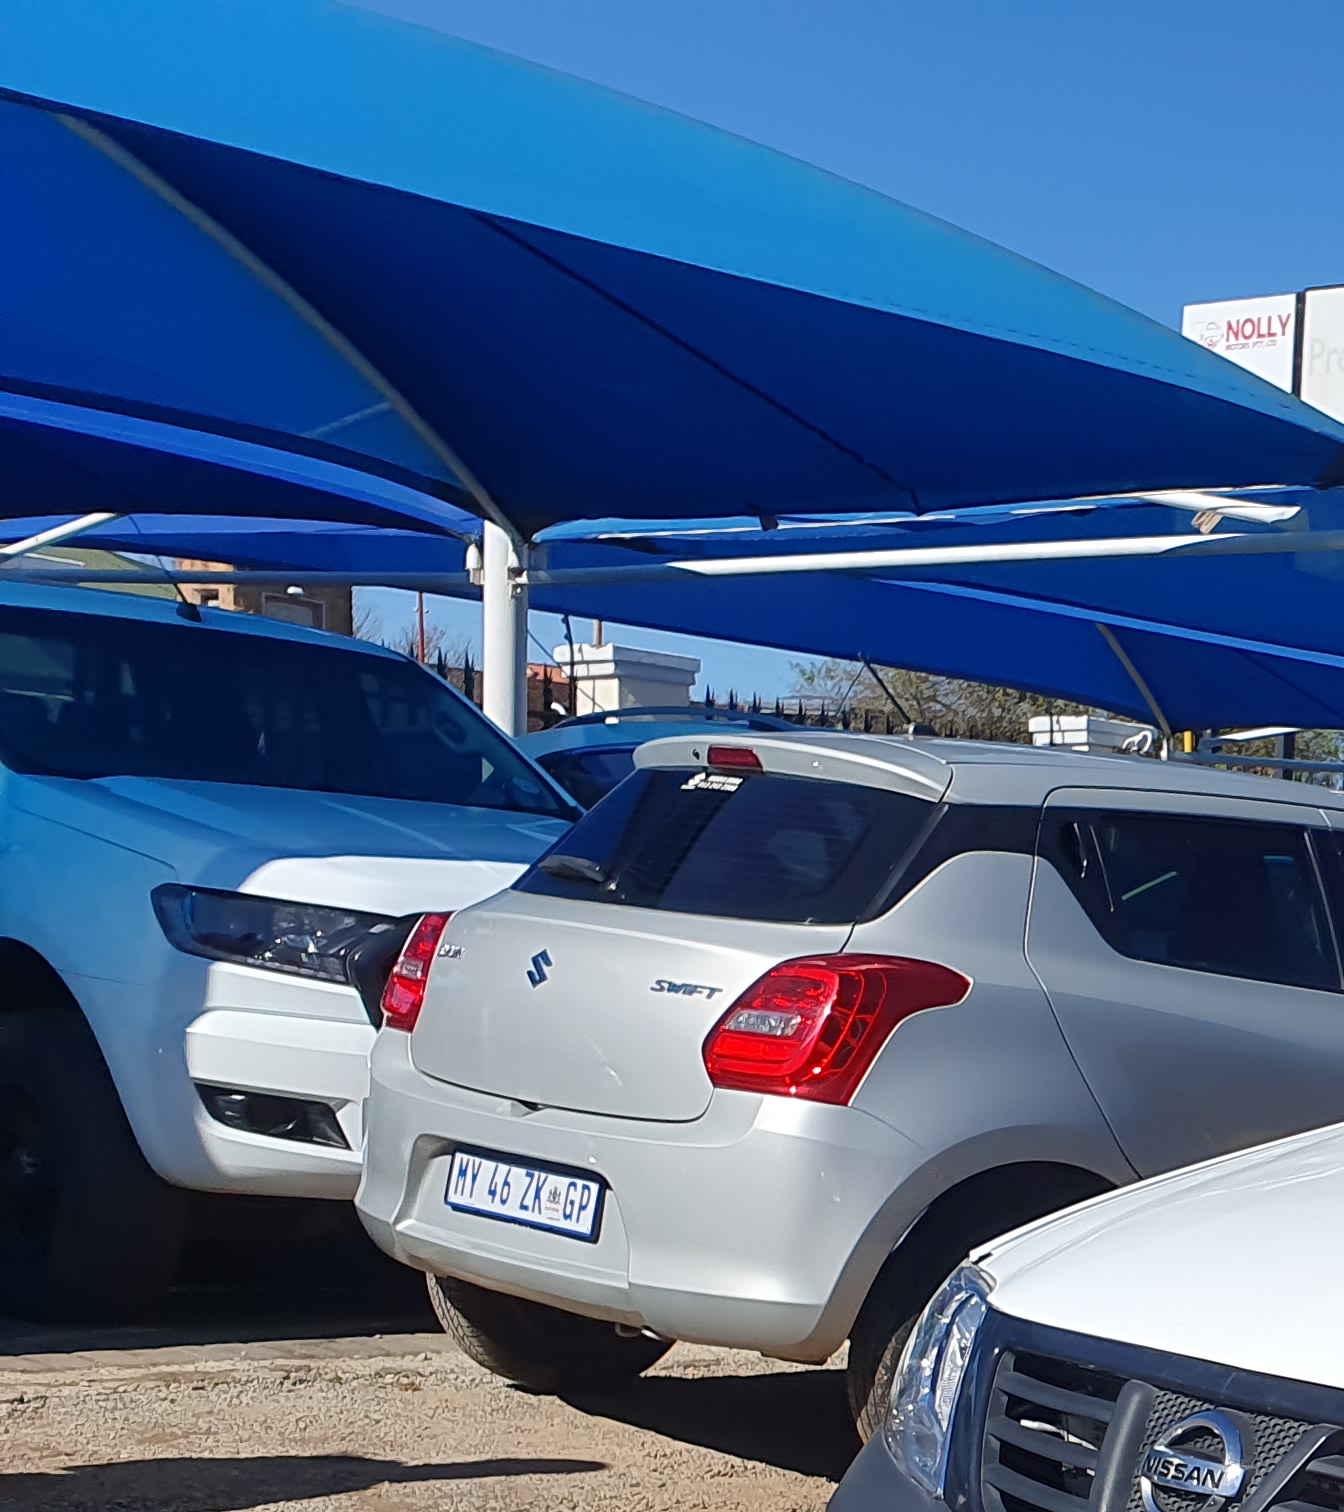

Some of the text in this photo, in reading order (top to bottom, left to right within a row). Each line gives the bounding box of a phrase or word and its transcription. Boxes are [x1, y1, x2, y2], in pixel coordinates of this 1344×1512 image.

[1226, 313, 1291, 342] NOLLY
[650, 979, 723, 1000] SWIFT
[454, 1157, 592, 1225] MY 46 ZK GP
[1143, 1455, 1225, 1490] NISSAN
